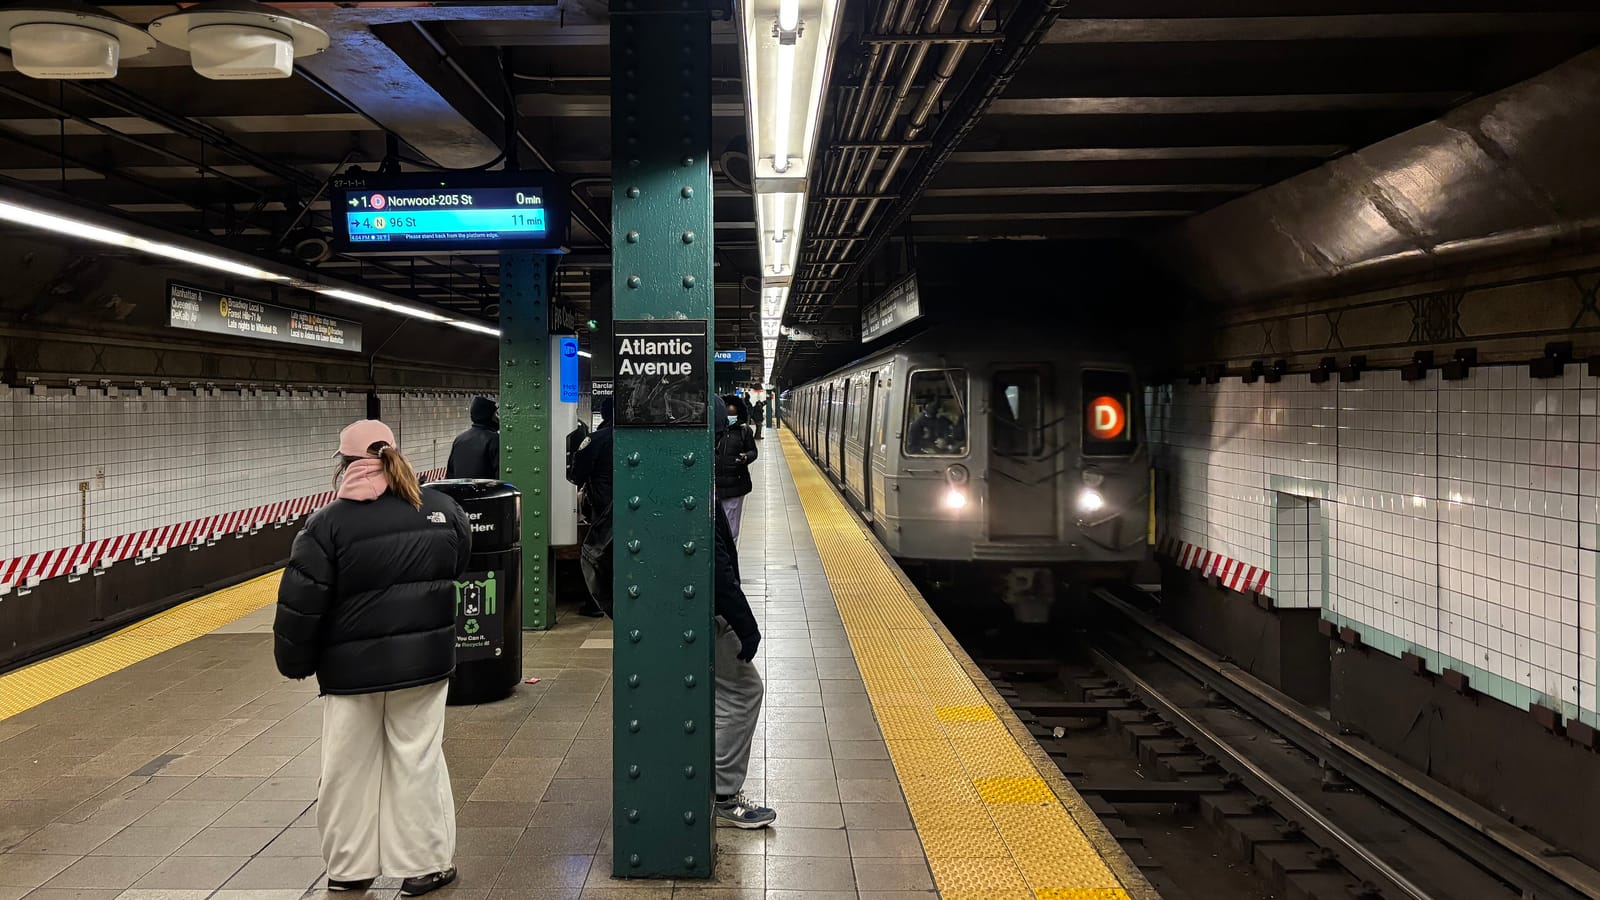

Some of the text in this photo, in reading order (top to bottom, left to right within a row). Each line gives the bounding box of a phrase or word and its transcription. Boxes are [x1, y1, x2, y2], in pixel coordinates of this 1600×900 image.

[361, 196, 371, 208] 1.
[388, 194, 458, 206] Norwood-205
[461, 194, 473, 206] St
[362, 217, 373, 229] 4.
[390, 217, 403, 228] 96
[406, 217, 416, 227] St
[512, 215, 524, 225] 11
[527, 217, 542, 225] min
[467, 232, 485, 240] platform
[171, 286, 197, 301] Manhattan
[228, 298, 248, 311] Broadway
[249, 302, 259, 313] Local
[171, 309, 197, 322] DeKalb Av
[228, 308, 241, 319] Forest
[228, 319, 237, 328] Late
[238, 320, 250, 331] nights
[256, 323, 272, 334] Whitehall
[619, 338, 693, 355] Atlantic
[619, 358, 692, 376] Avenue
[1095, 405, 1117, 431] D
